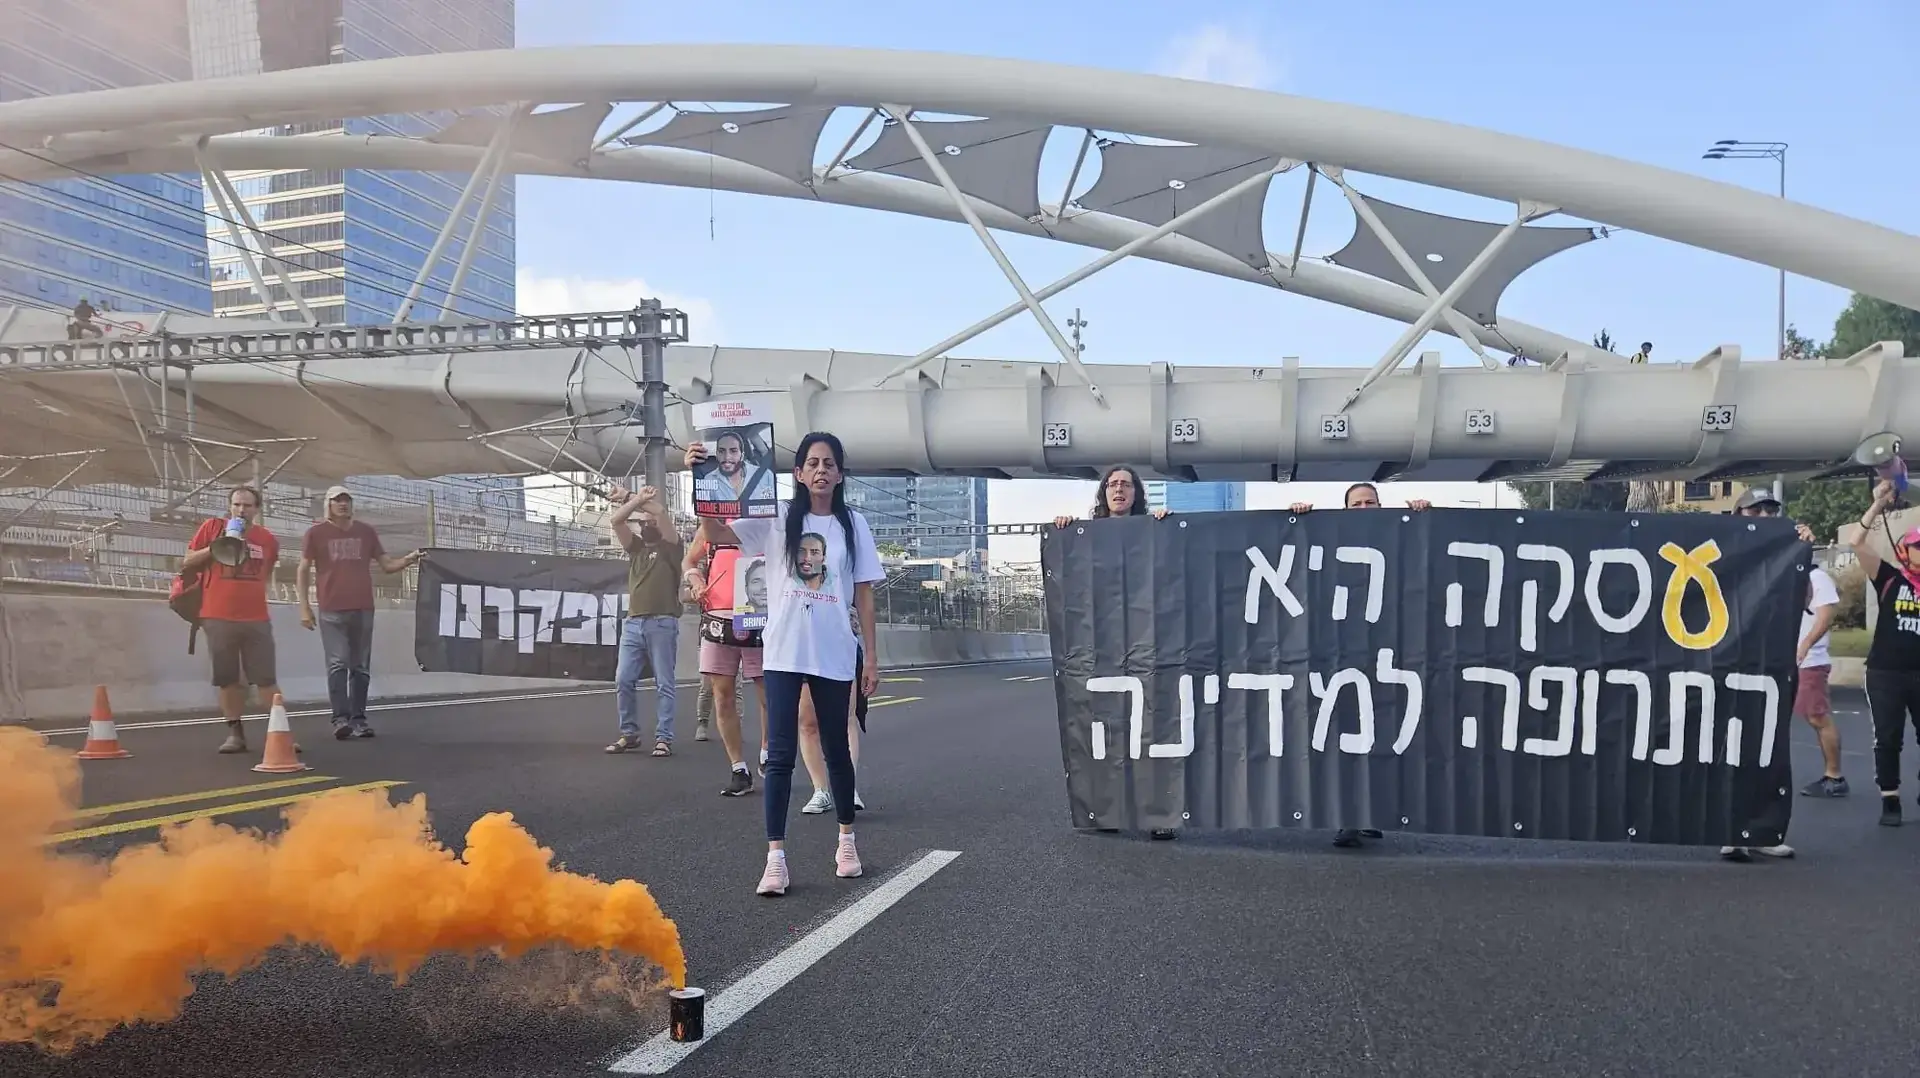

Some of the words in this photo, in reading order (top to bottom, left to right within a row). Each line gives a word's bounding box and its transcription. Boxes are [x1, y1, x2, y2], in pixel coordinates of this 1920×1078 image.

[1469, 414, 1492, 428] 5.3
[1705, 411, 1732, 425] 5.3
[1174, 424, 1195, 437] 5.3
[1324, 420, 1346, 433] 5.3
[1047, 428, 1067, 441] 5.3
[697, 501, 718, 514] HOME
[719, 502, 741, 514] NOW!
[1244, 544, 1386, 624] היא
[1444, 538, 1730, 652] עסקה
[743, 616, 767, 628] BRING
[1086, 648, 1424, 760] למדינה
[1461, 665, 1780, 768] התרופה
